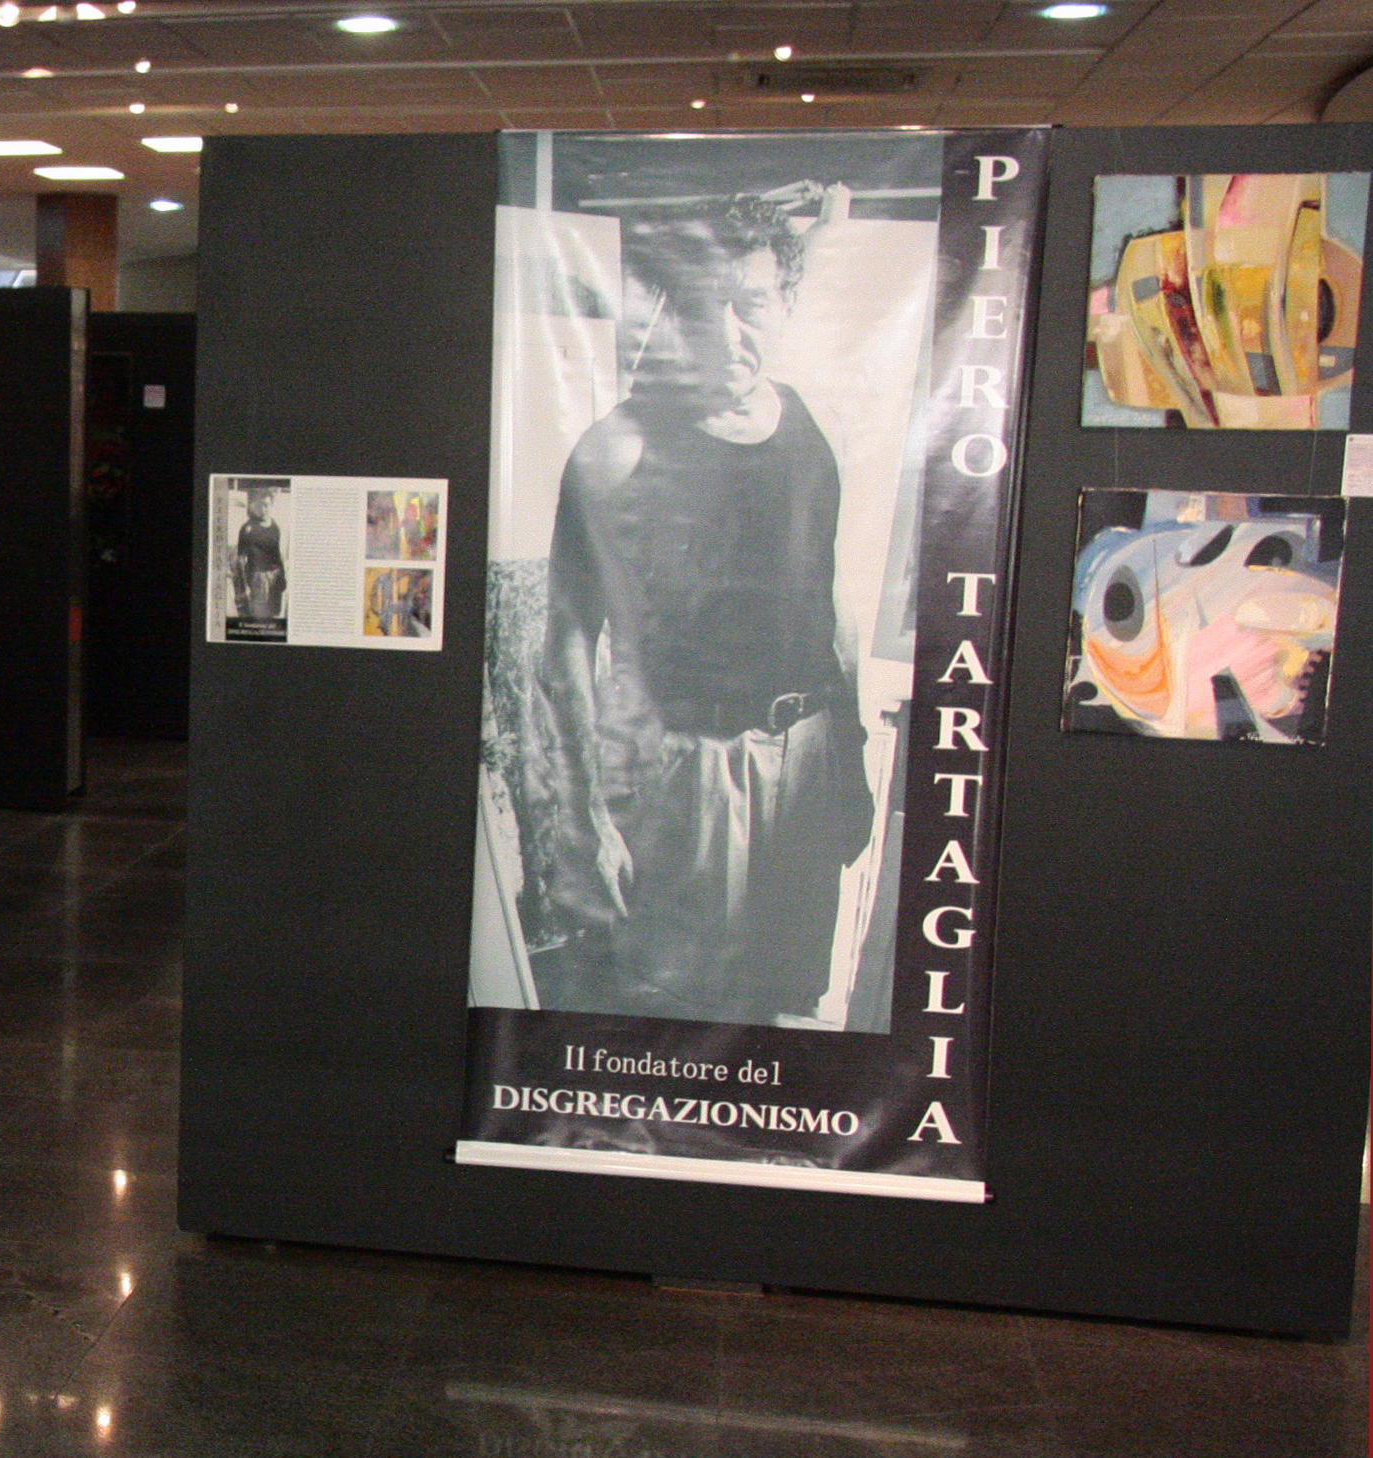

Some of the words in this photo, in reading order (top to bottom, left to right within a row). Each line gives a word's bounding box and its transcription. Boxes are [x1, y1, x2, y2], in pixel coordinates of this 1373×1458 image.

[950, 155, 1020, 478] PIERO
[907, 572, 997, 1145] TARTAGLIA
[492, 1083, 860, 1137] DISGREGAZIONISMO
[563, 1045, 586, 1071] Il
[593, 1048, 729, 1083] fondatore
[737, 1059, 782, 1086] del
